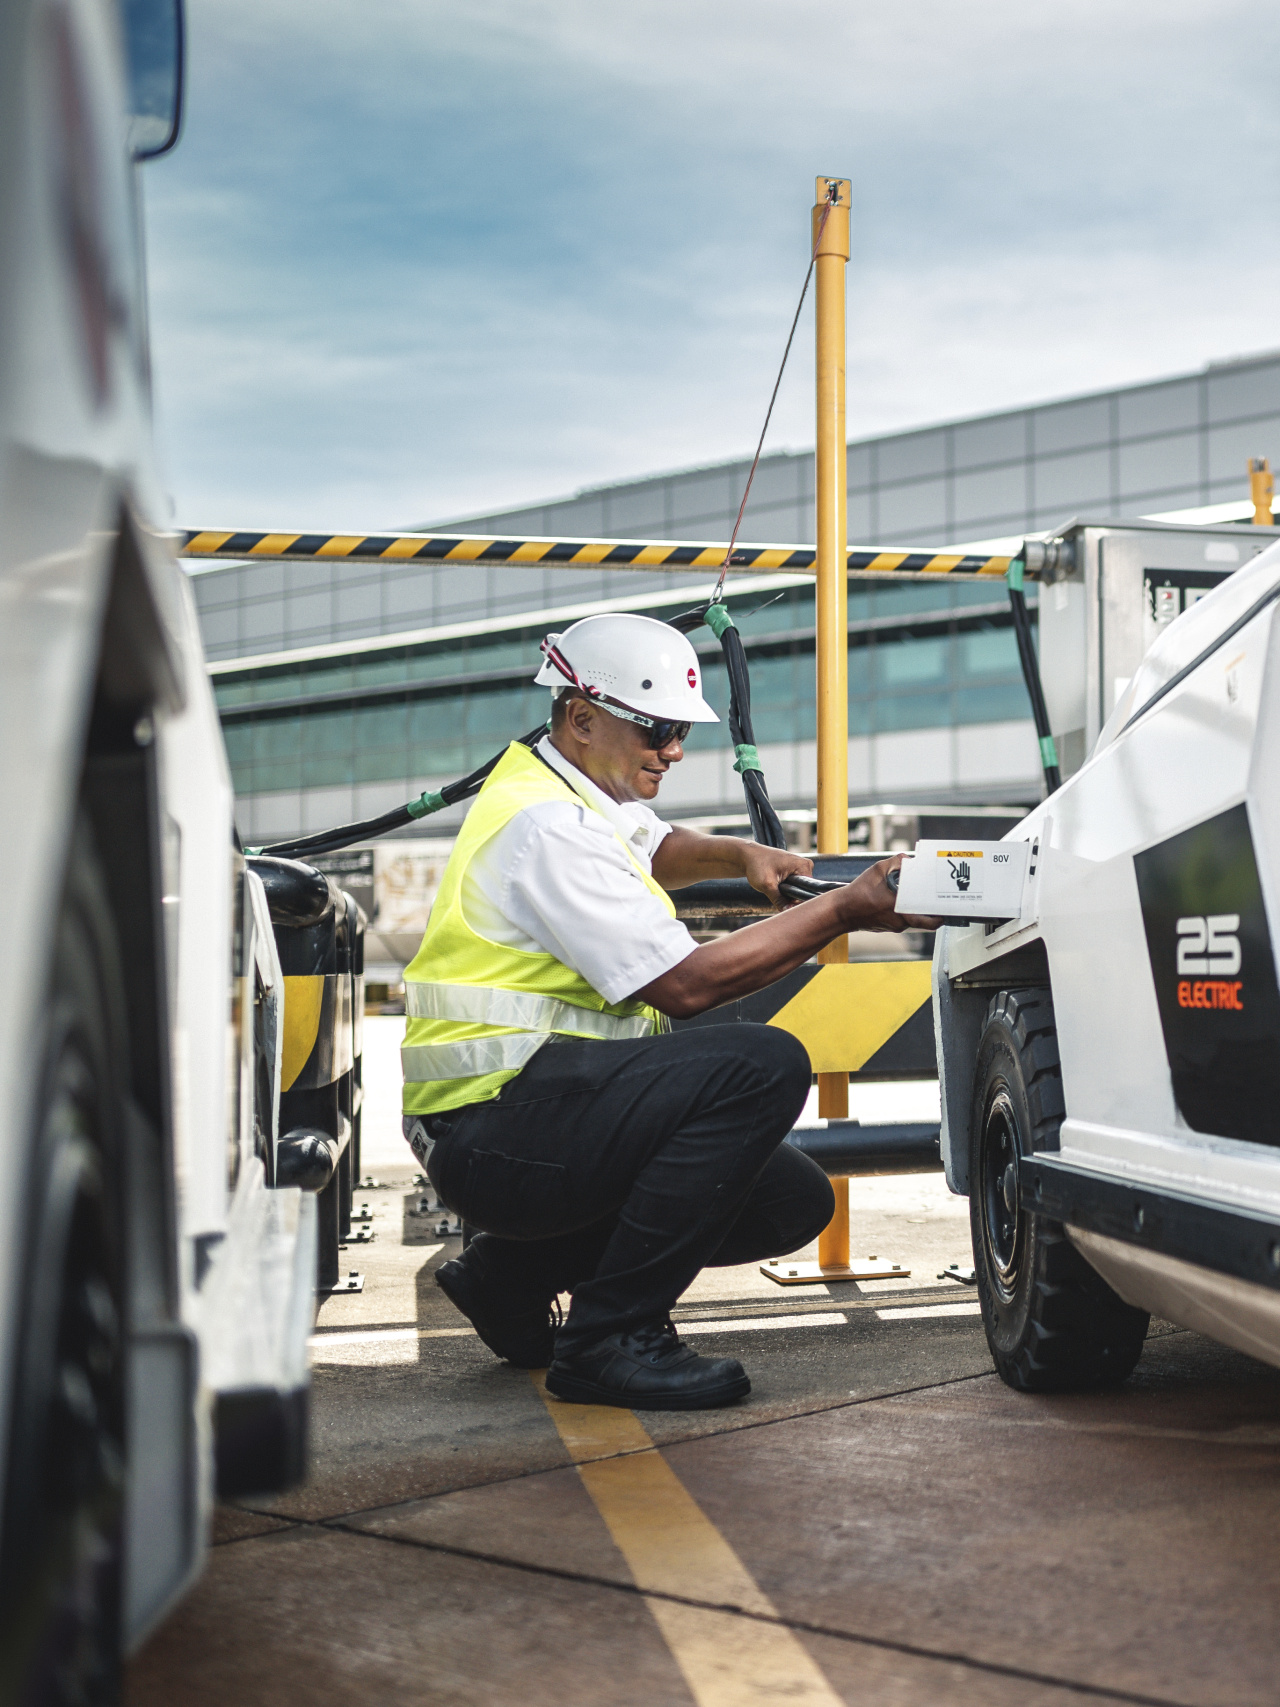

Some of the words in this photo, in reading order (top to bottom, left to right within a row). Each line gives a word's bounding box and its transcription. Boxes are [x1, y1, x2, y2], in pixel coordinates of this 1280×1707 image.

[993, 855, 1009, 863] 80V
[1176, 914, 1242, 975] 25
[1177, 981, 1244, 1010] ELECTRIC
